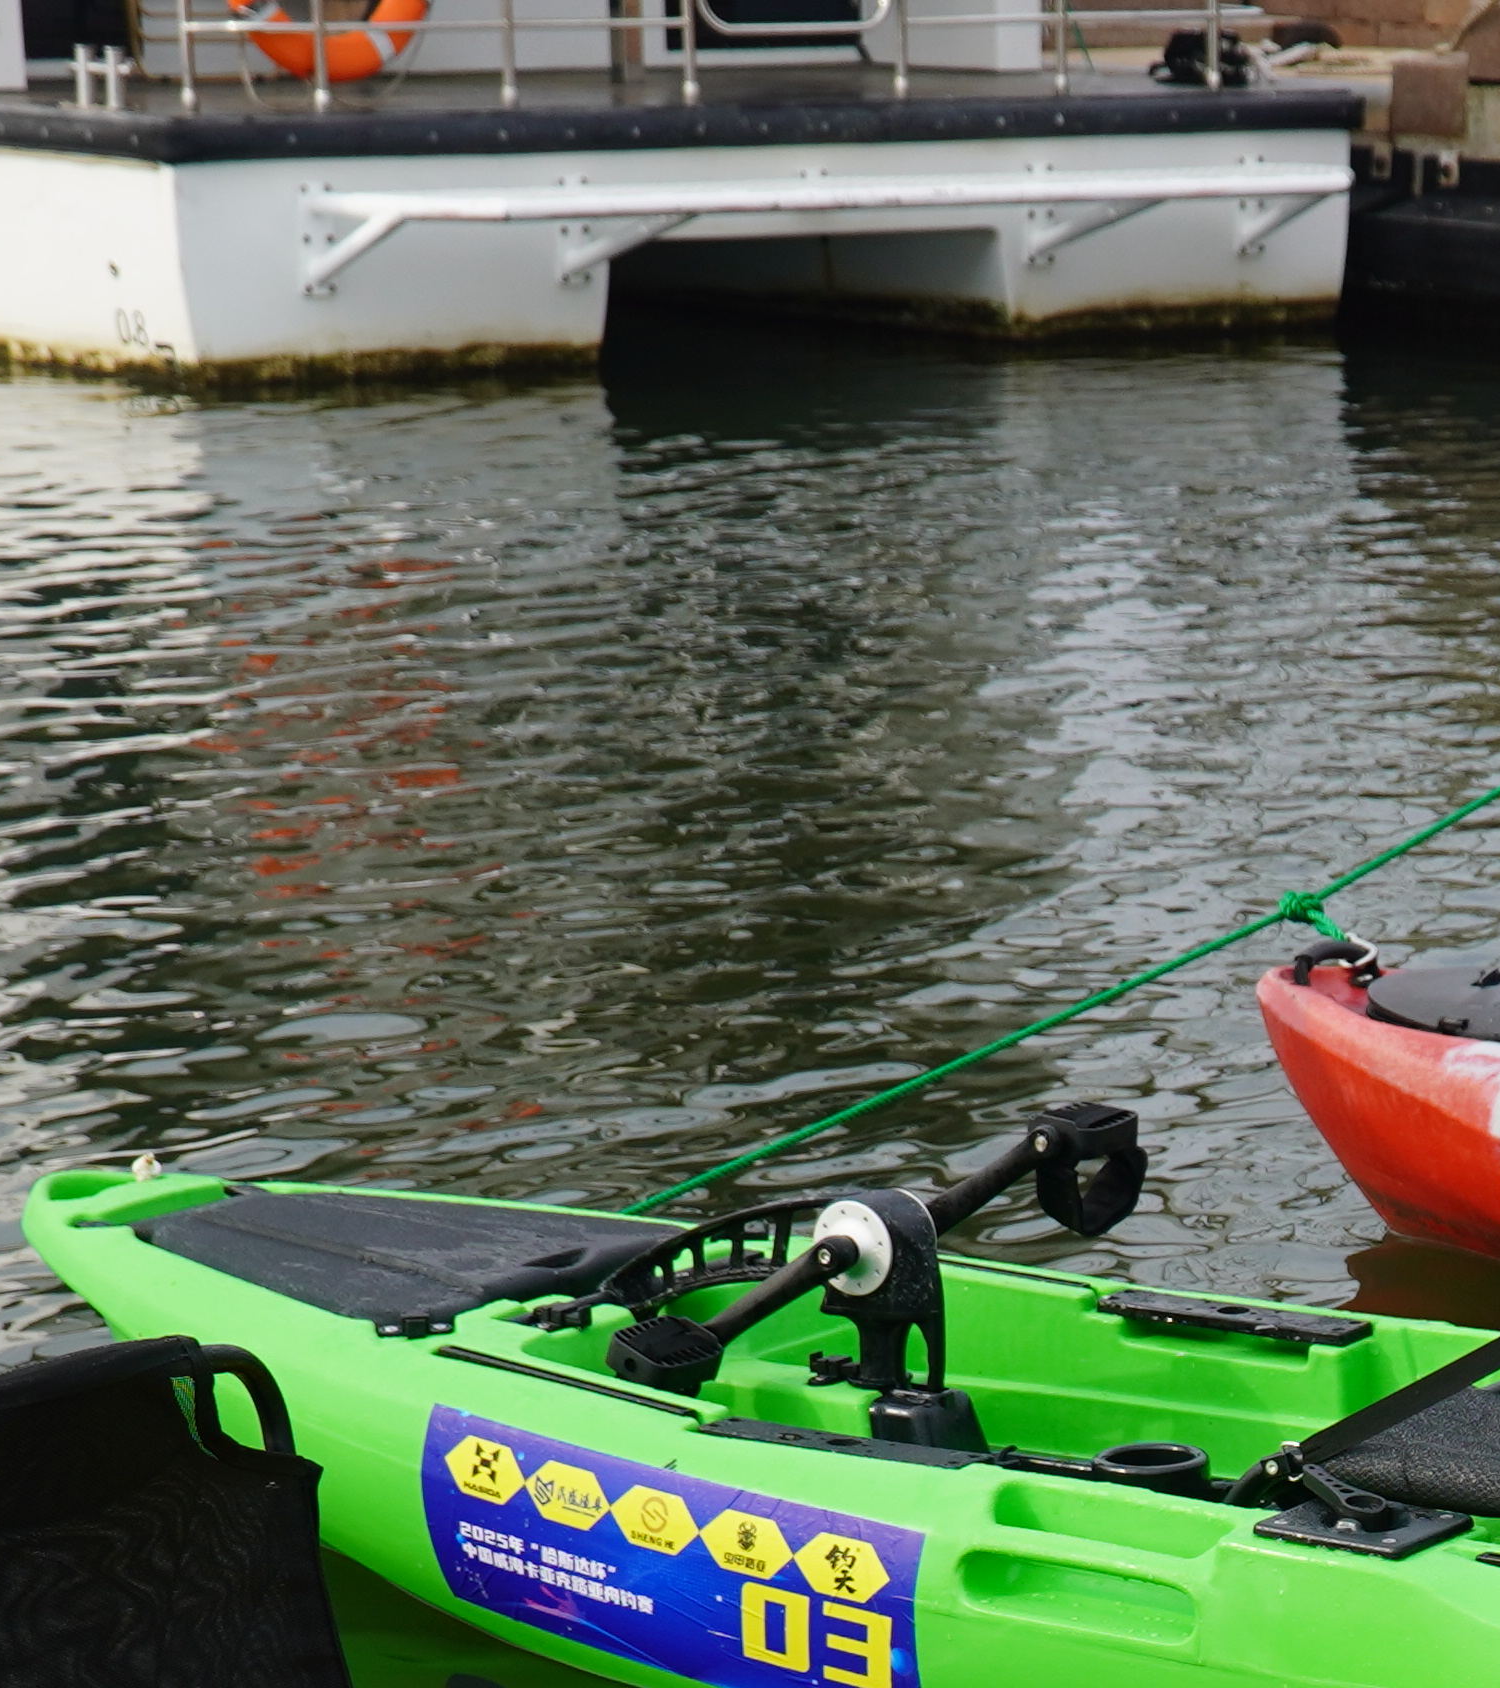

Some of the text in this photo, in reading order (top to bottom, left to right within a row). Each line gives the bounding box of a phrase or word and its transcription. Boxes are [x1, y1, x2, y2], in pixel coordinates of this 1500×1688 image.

[630, 1529, 675, 1551] SHENG HE
[824, 1544, 857, 1594] 钓天
